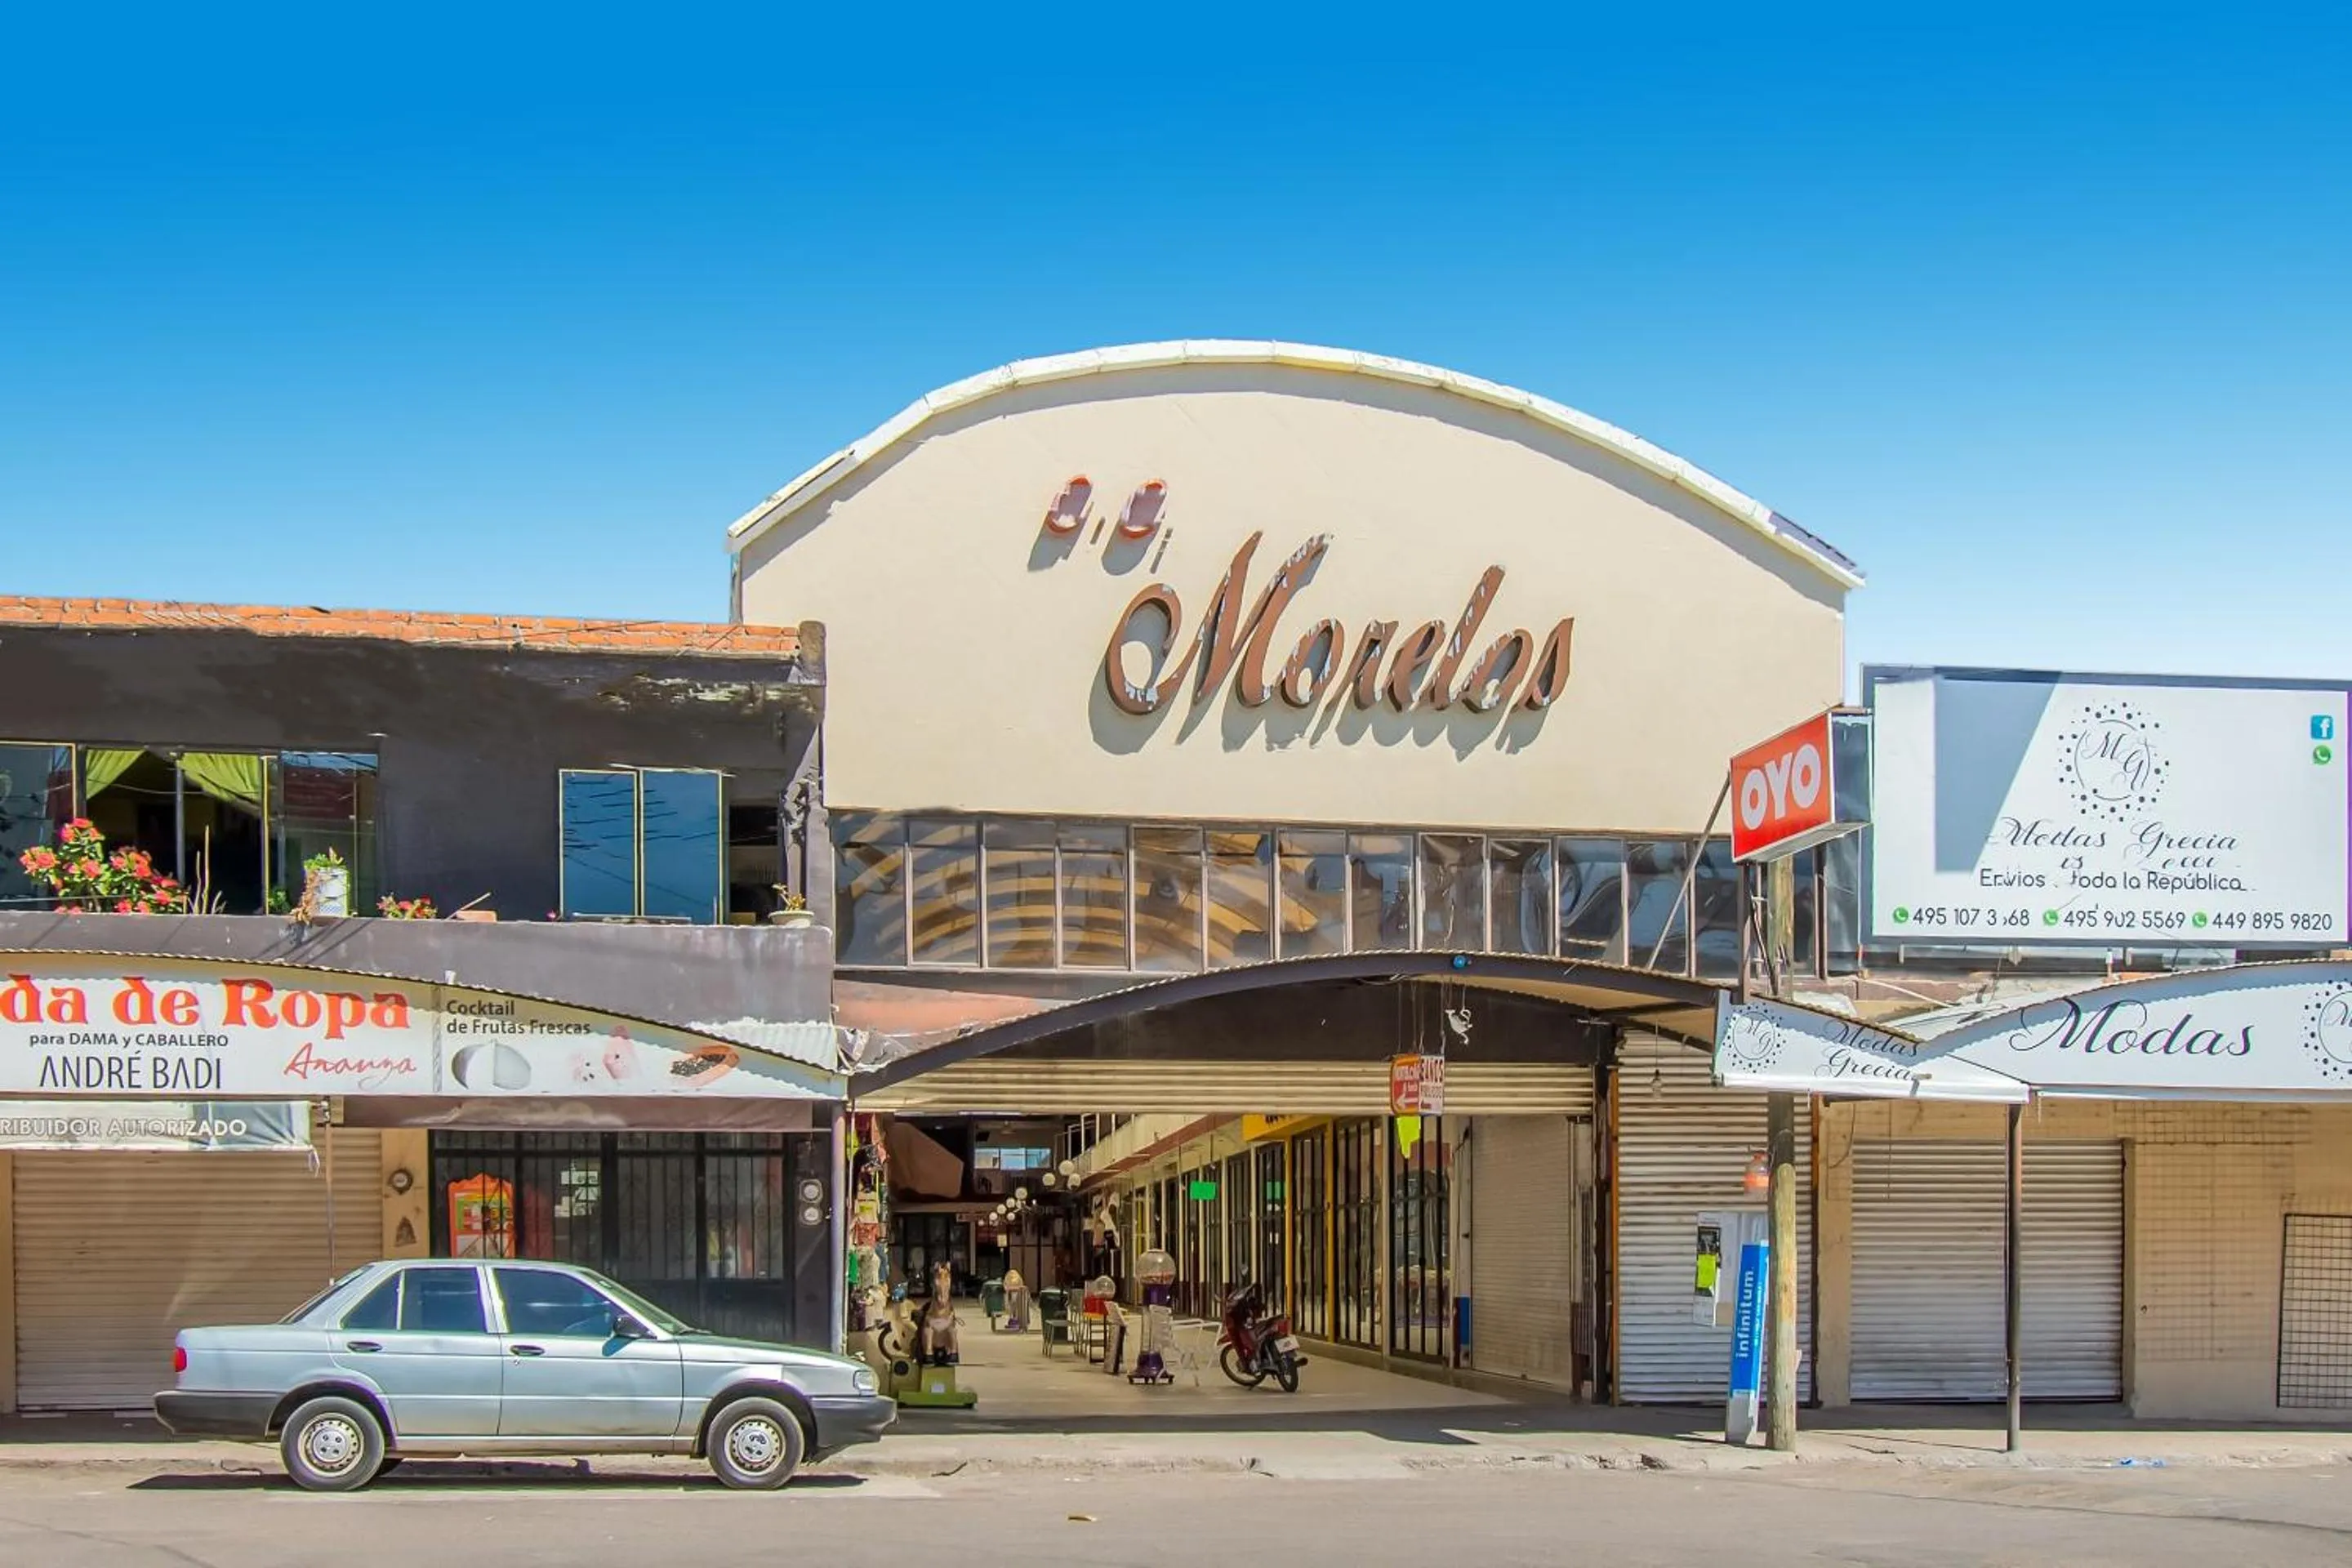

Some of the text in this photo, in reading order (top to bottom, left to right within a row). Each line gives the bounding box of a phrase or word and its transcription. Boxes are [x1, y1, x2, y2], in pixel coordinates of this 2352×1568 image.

[1106, 530, 1574, 715] Morelos
[1740, 743, 1821, 831] OYO
[2123, 871, 2140, 889] la
[1913, 907, 2030, 926] 495 107 368
[2064, 910, 2097, 927] 495
[2141, 911, 2186, 929] 5569
[2212, 911, 2332, 931] 449 895 9820
[112, 976, 200, 1026] de
[221, 978, 410, 1040] Ropa
[447, 1000, 514, 1015] Cocktail
[447, 1018, 590, 1035] de Frutas Frescas
[1820, 1020, 1920, 1058] Modas
[2009, 996, 2256, 1056] Modas
[29, 1032, 229, 1049] para DAMA y CABALLERO
[39, 1050, 221, 1089] ANDRÉ BADI
[1815, 1047, 1915, 1080] Grecia
[0, 1118, 247, 1137] RIBUIDOR AUTORIZADO
[1735, 1270, 1754, 1358] infinitum
